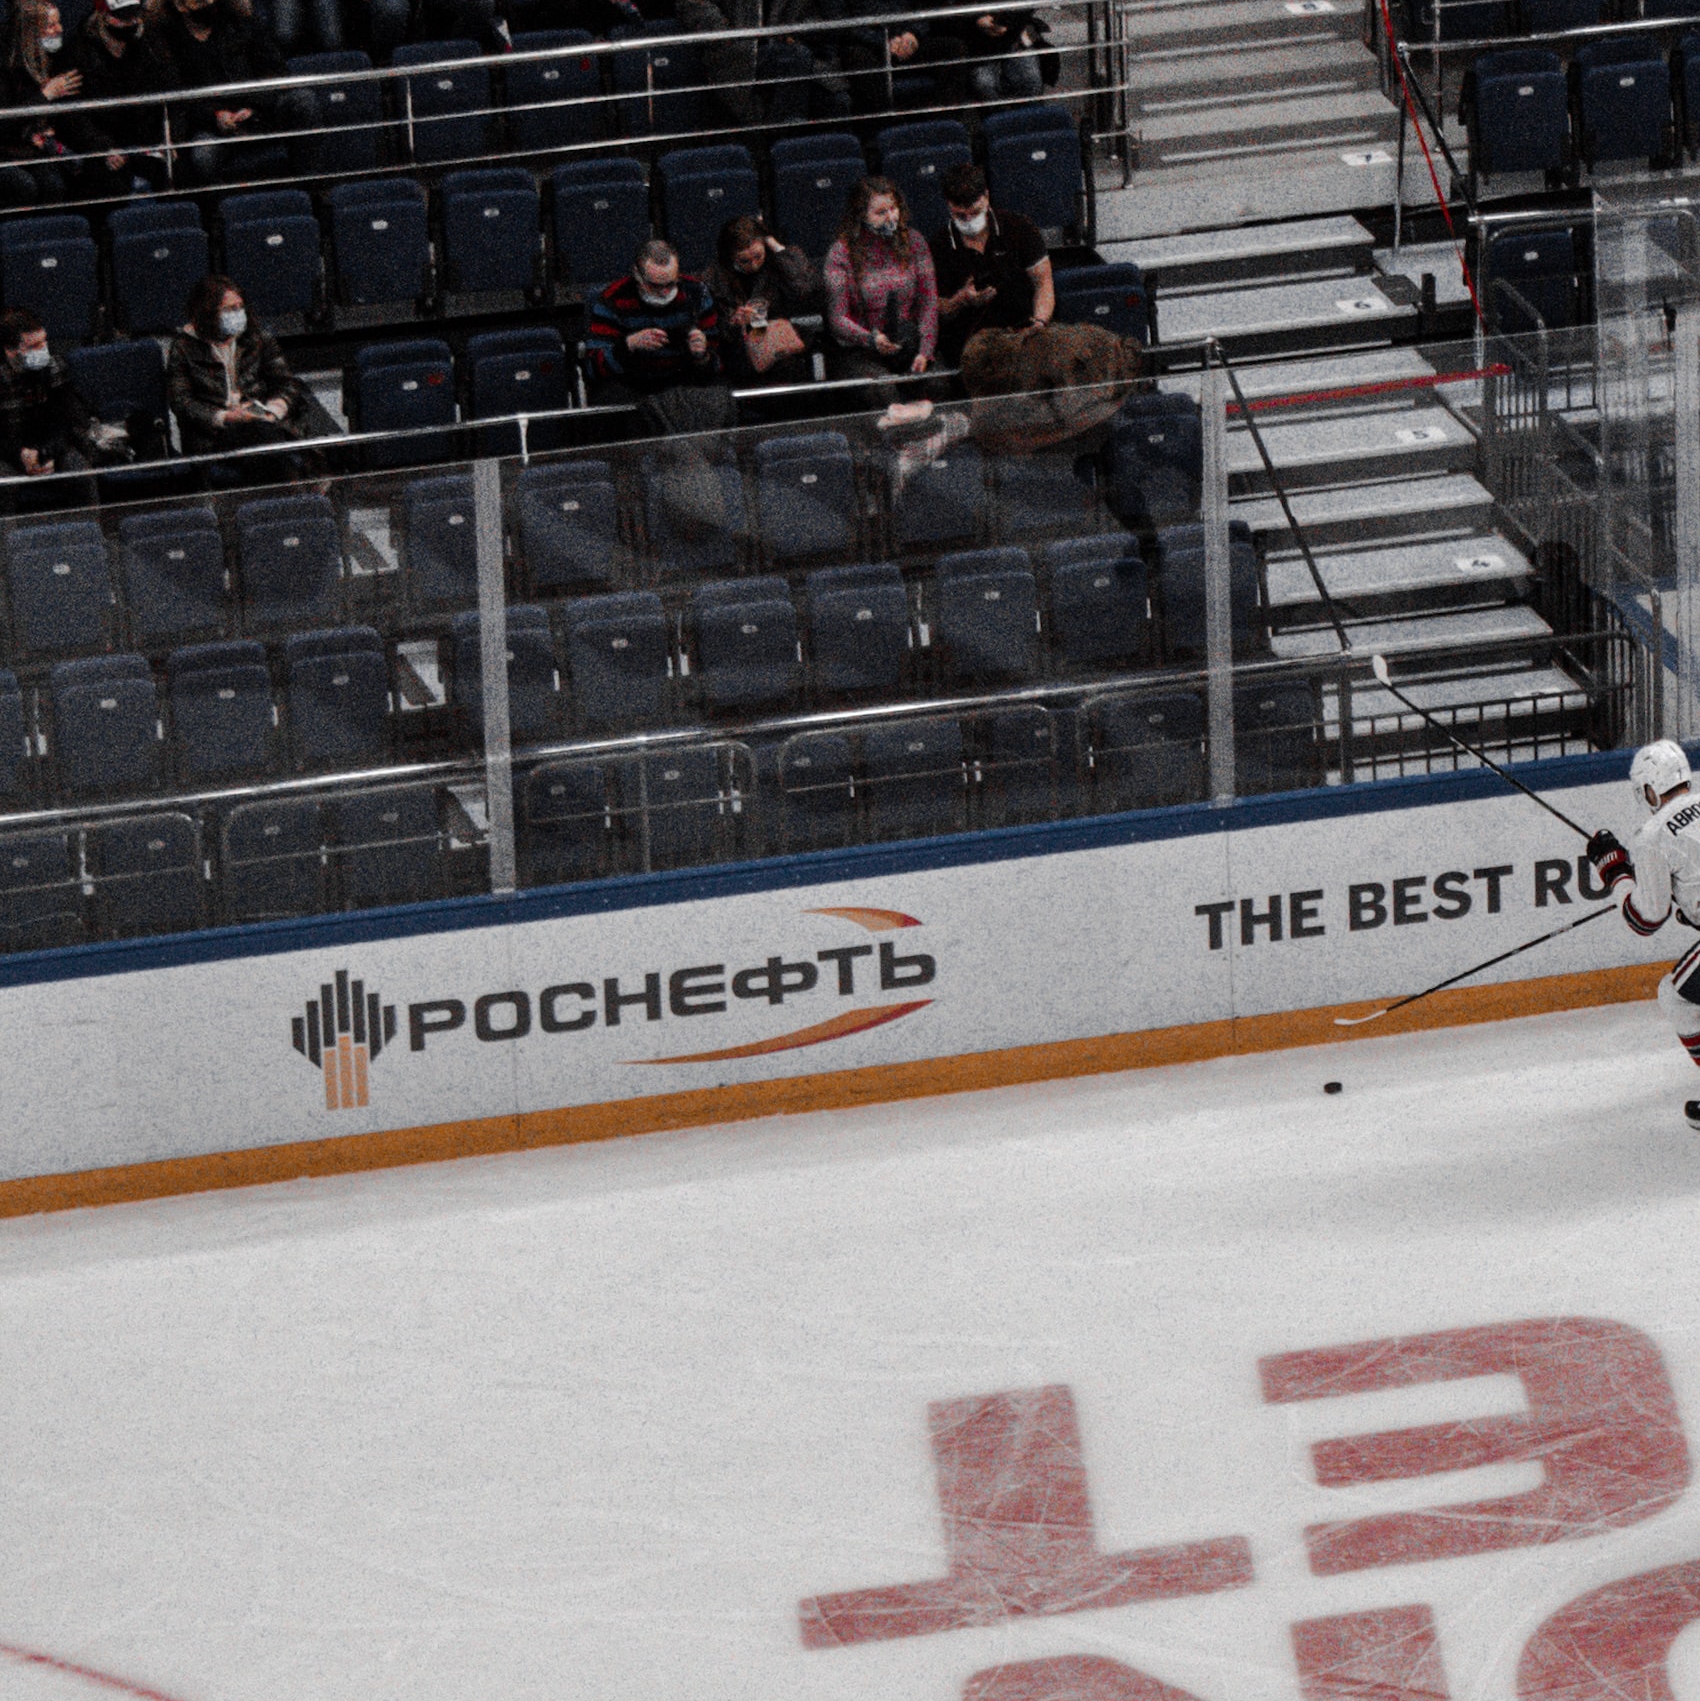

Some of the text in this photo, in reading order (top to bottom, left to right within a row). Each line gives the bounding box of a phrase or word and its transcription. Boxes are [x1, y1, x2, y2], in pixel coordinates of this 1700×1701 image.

[1196, 889, 1326, 950] THE
[1348, 865, 1514, 932] BEST
[410, 941, 937, 1051] РОСНЕФТЬ
